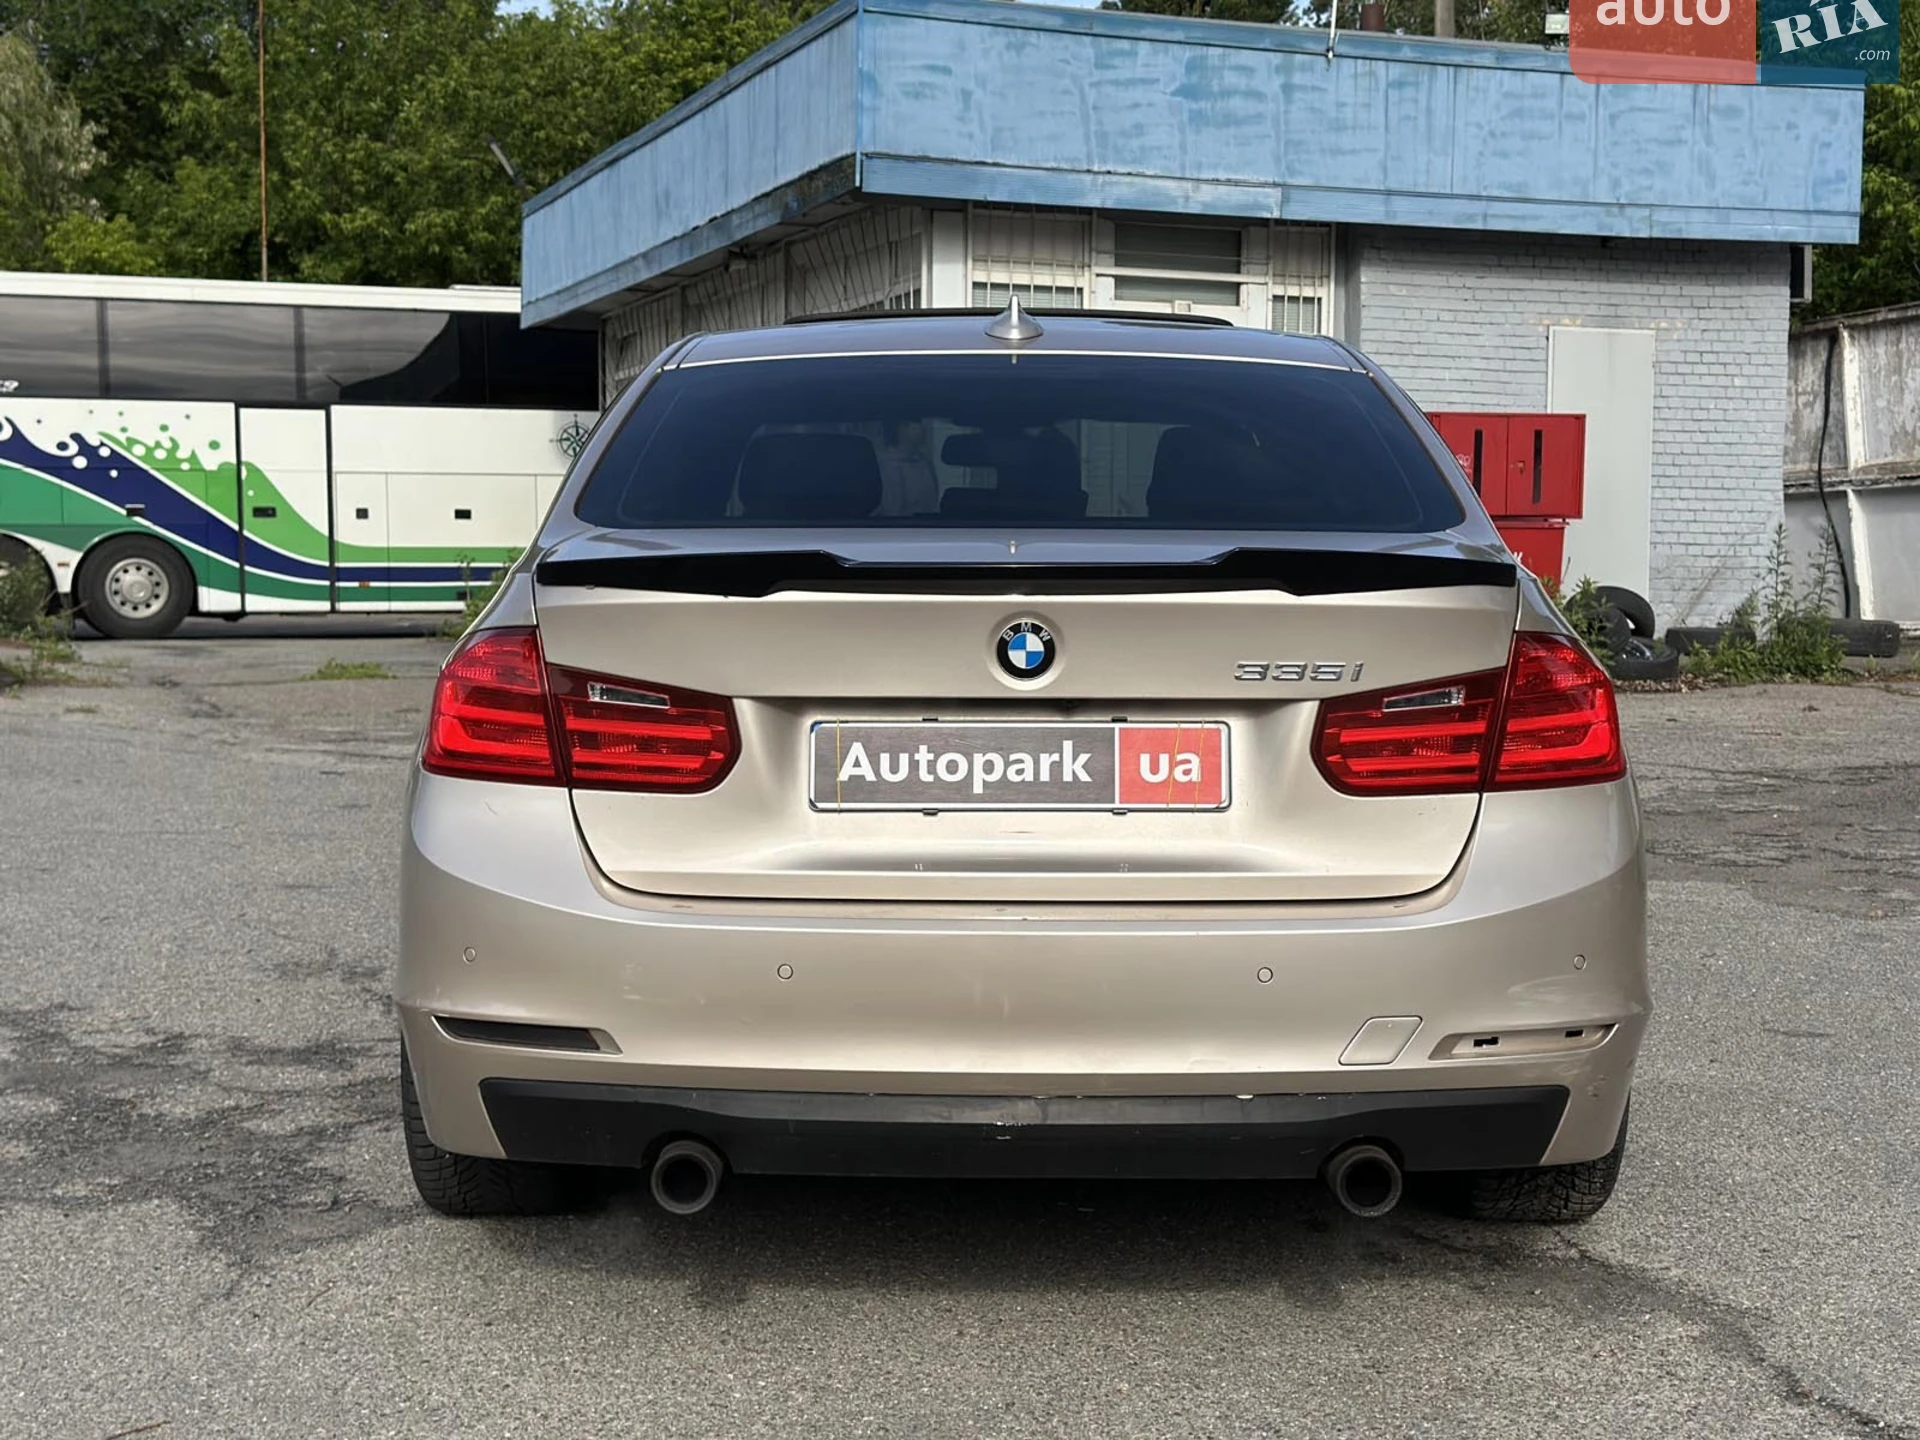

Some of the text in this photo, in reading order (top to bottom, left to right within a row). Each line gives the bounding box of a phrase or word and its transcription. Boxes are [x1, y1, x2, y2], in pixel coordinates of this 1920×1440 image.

[1002, 621, 1051, 642] BMW
[1234, 660, 1364, 682] 335i
[837, 740, 1201, 794] Autopark ua
